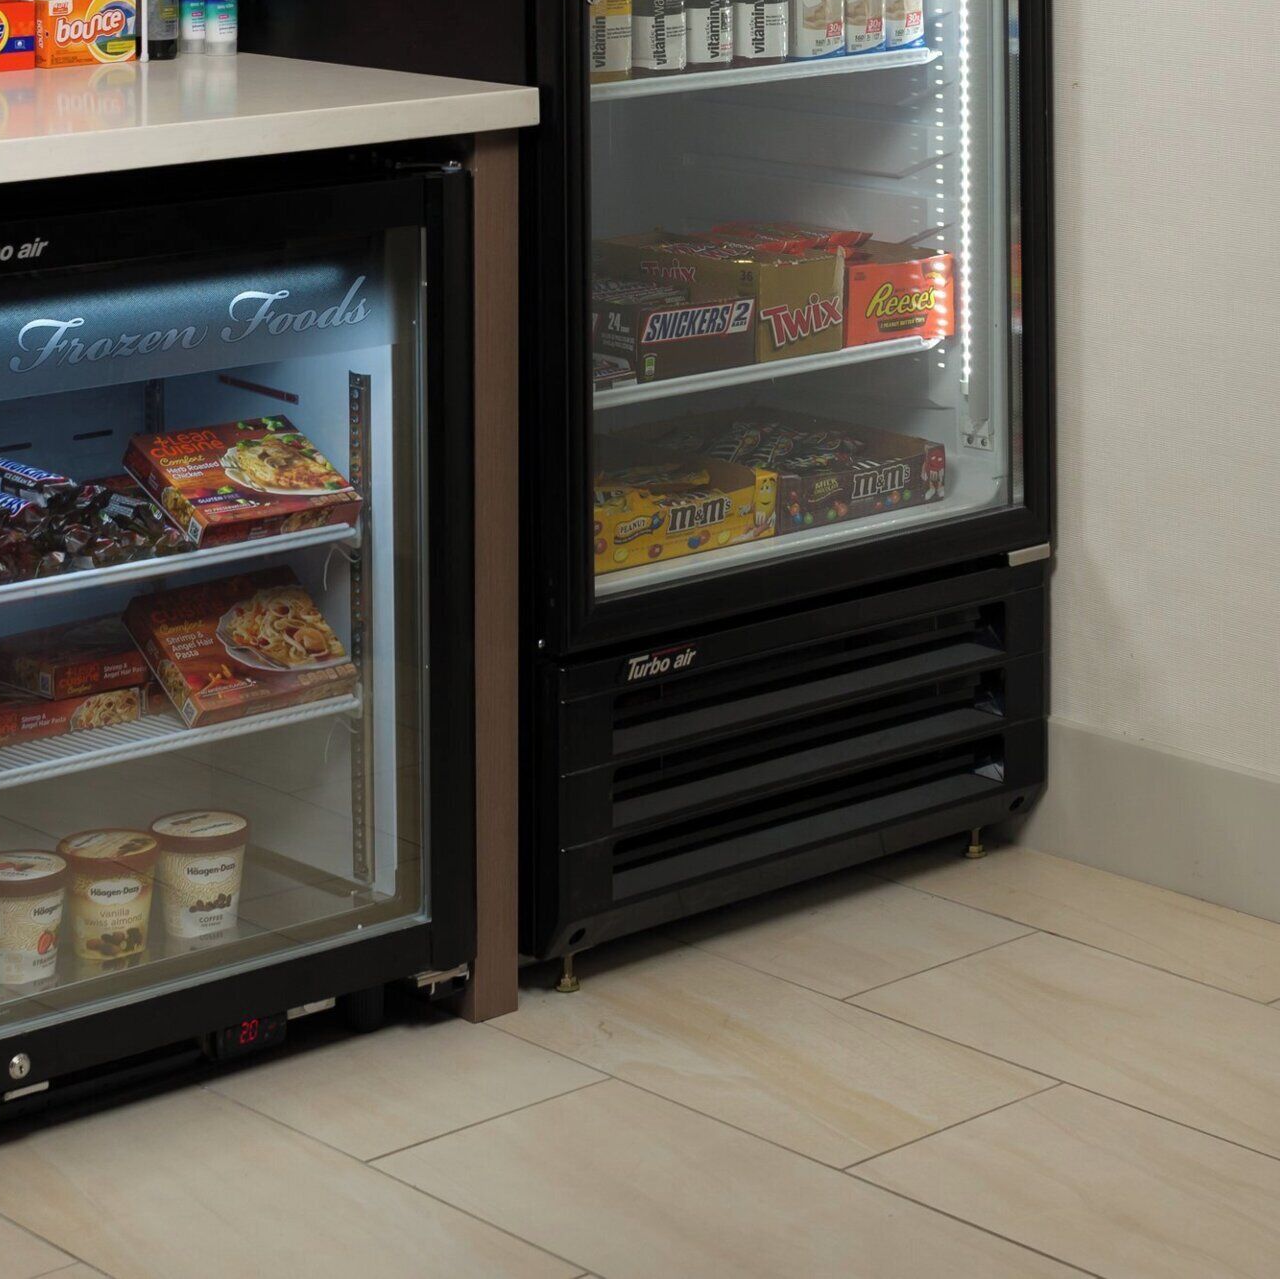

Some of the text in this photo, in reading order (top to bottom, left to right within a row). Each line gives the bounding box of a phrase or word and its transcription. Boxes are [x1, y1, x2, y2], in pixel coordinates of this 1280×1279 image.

[56, 9, 123, 45] bounce
[17, 237, 49, 259] air
[739, 270, 753, 282] 36
[865, 282, 936, 319] Reese's
[9, 275, 372, 373] Frozen Foods
[608, 312, 621, 331] 24
[645, 305, 727, 342] SNICKERS
[733, 302, 750, 321] 2
[160, 455, 206, 467] Comfort
[167, 461, 220, 475] Herb Roasted
[173, 470, 204, 480] Chicken
[197, 495, 223, 504] GLUTEN
[620, 520, 646, 534] PEANUT
[160, 620, 205, 633] Comfort
[166, 632, 196, 645] Shrimp
[172, 638, 214, 653] Angel Hair
[175, 650, 200, 660] Pasta
[103, 665, 122, 673] Shrimp
[627, 648, 696, 681] Turbo air
[104, 668, 132, 680] Angel Hair
[21, 715, 40, 724] Shrimp
[21, 716, 67, 730] Angel Pasta
[187, 861, 236, 876] Häagen-Dazs
[90, 885, 140, 898] Häagen-Dazs
[110, 913, 143, 926] almond
[199, 914, 224, 924] COFFEE
